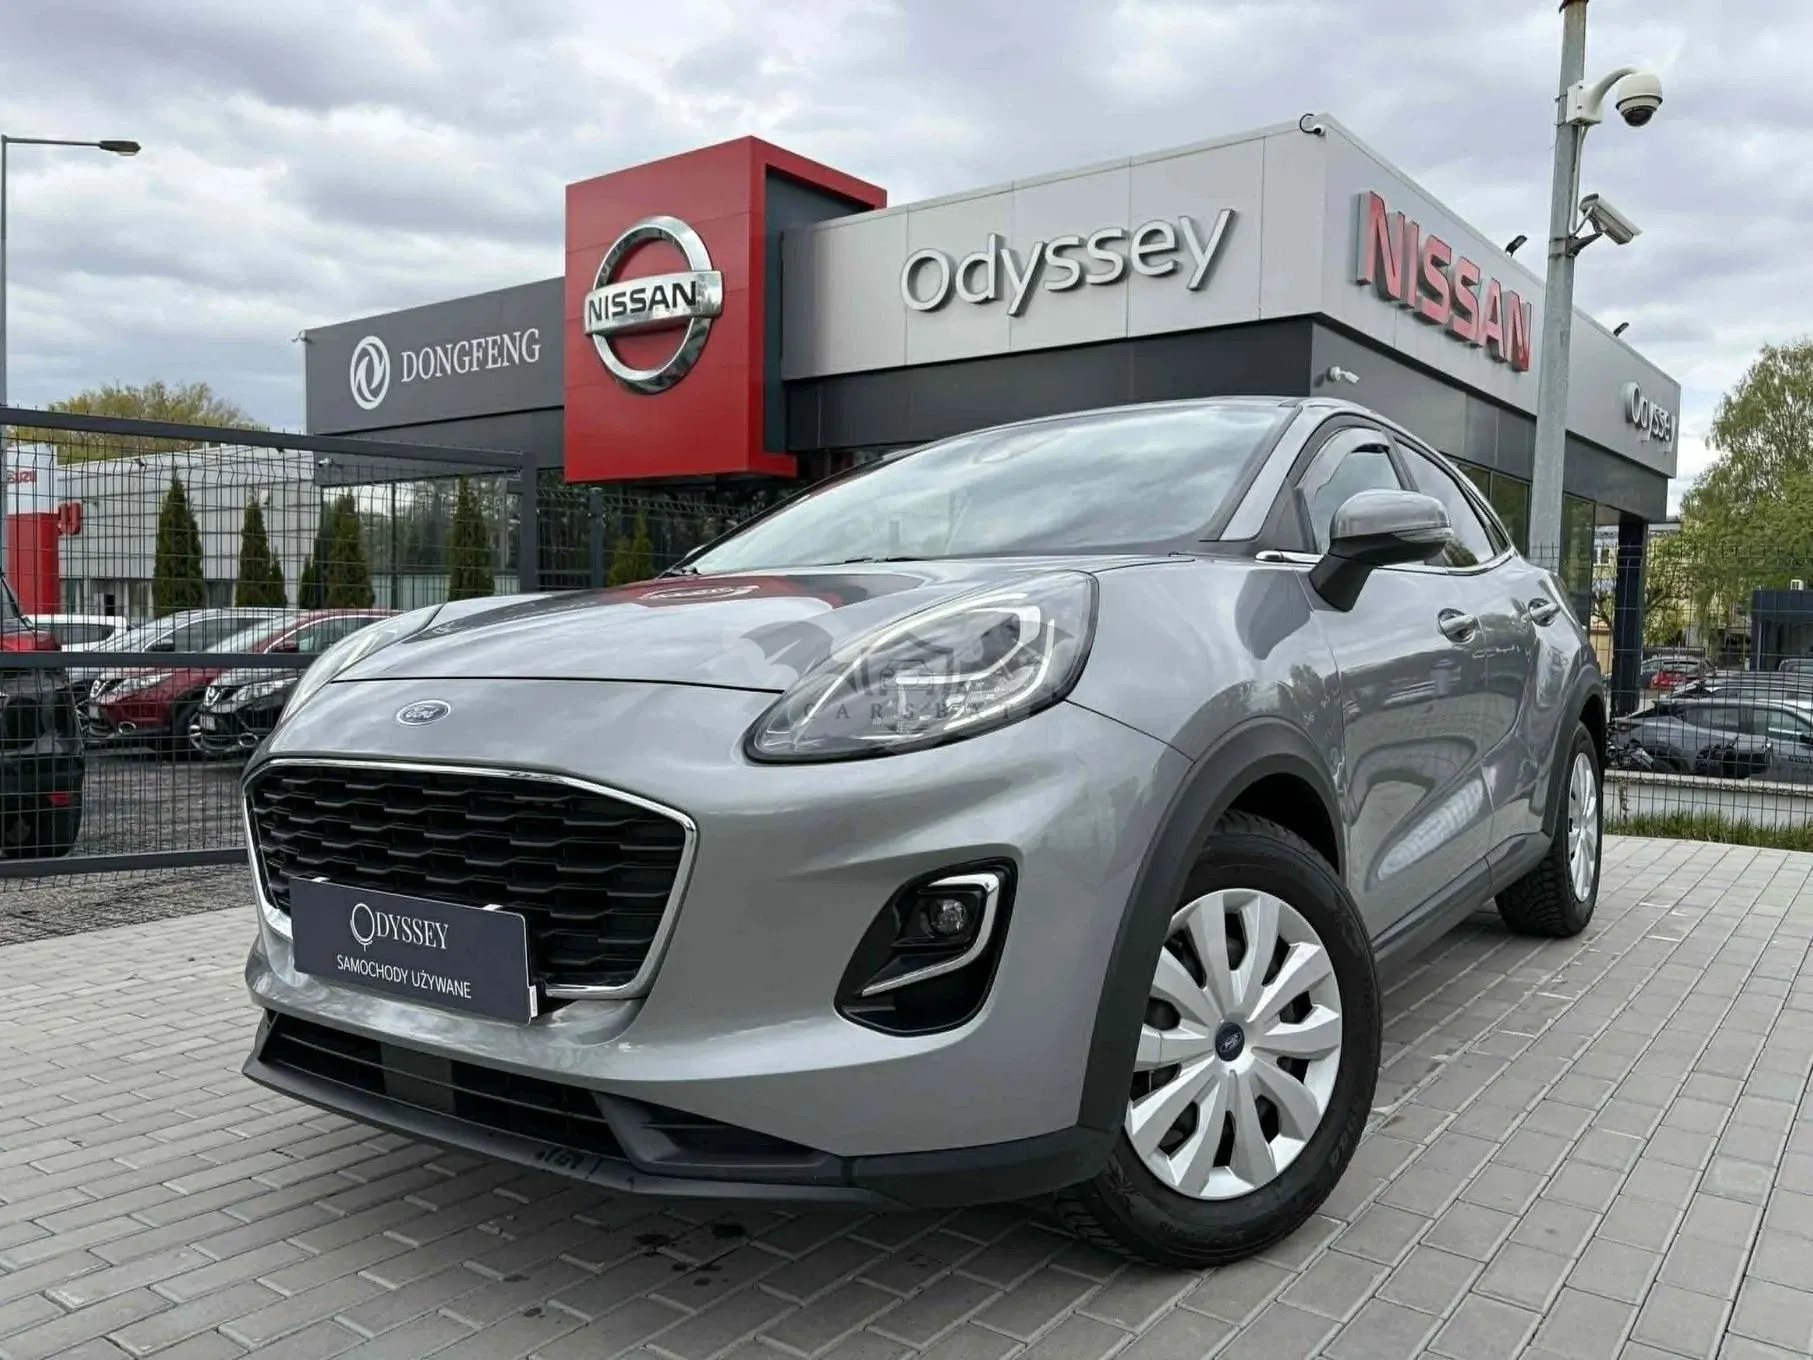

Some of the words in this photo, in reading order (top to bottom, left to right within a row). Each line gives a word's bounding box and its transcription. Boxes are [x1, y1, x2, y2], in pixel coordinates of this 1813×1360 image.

[900, 208, 1236, 316] Odyssey
[1357, 190, 1533, 372] NISSAN
[588, 279, 698, 323] NISSAN
[400, 327, 541, 383] DONGFENG
[1627, 382, 1676, 452] Odyssey
[350, 902, 449, 951] ODYSSEY
[336, 954, 409, 985] SAMOCHODY
[411, 969, 473, 999] UŻYWANE
